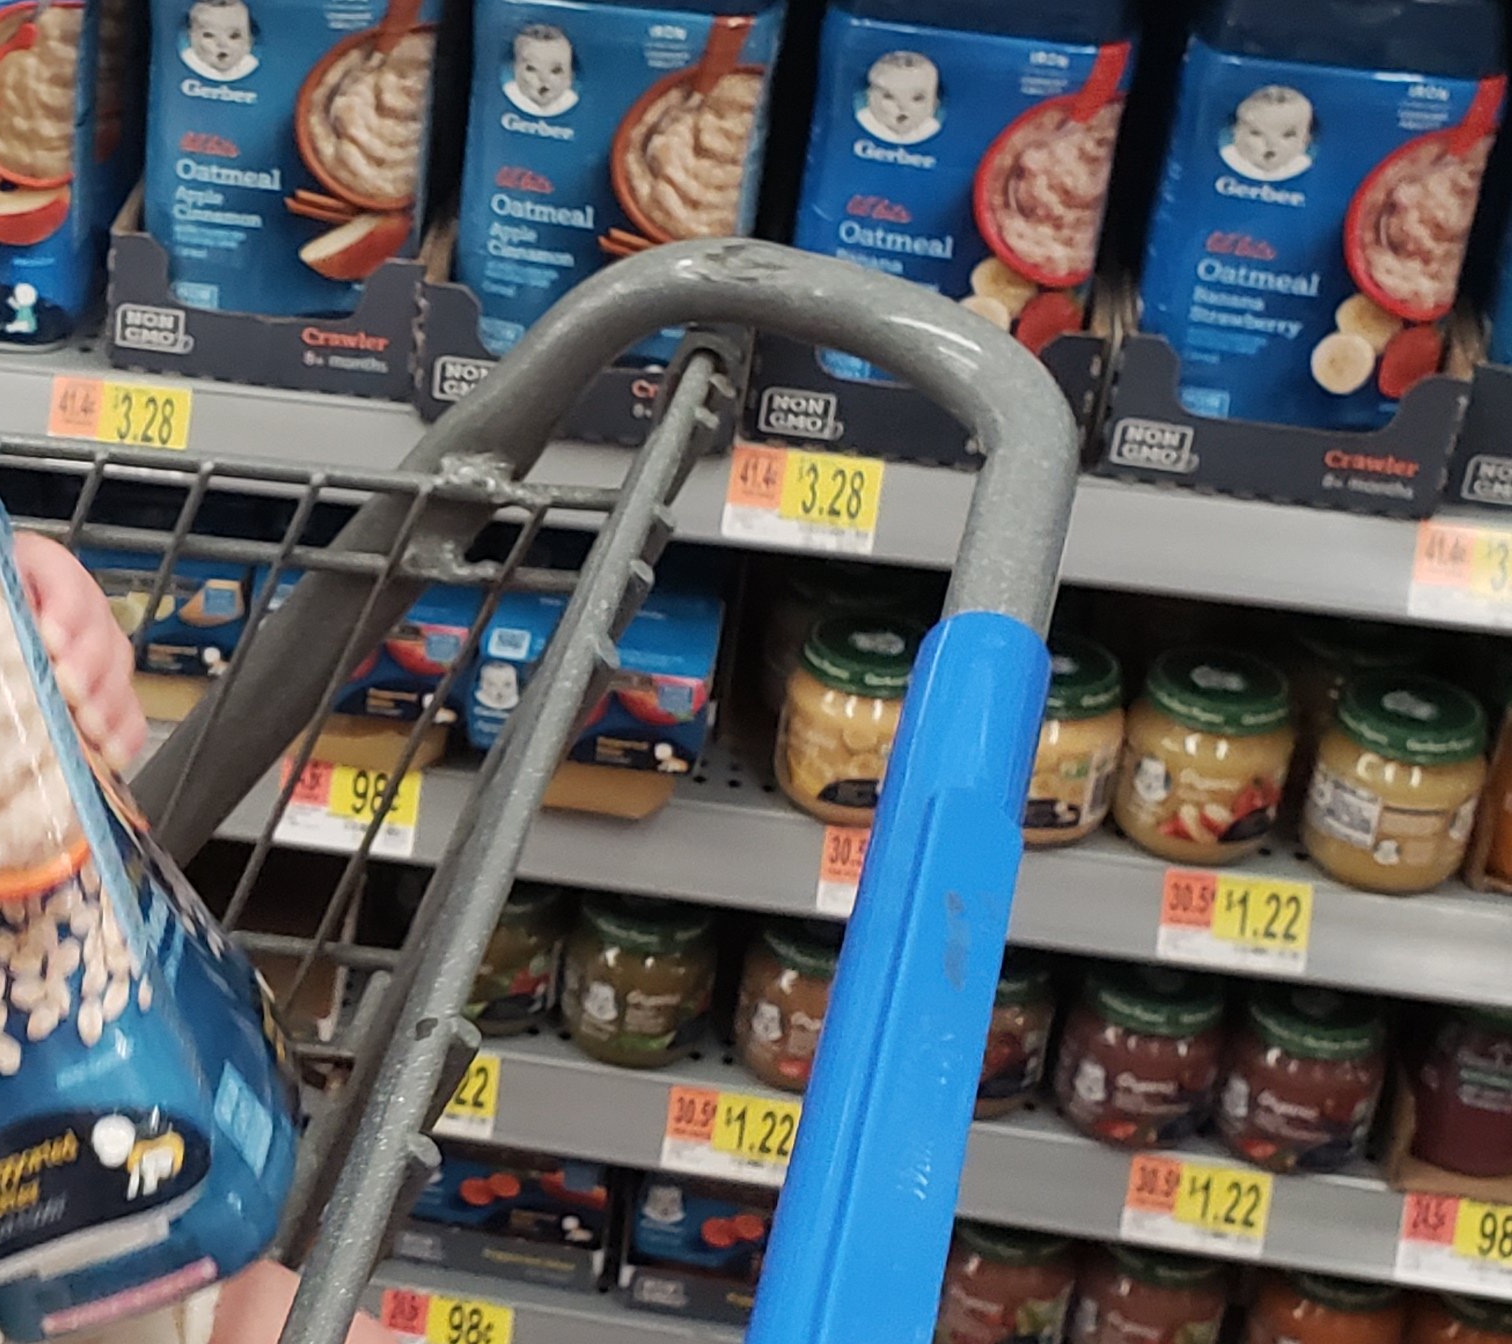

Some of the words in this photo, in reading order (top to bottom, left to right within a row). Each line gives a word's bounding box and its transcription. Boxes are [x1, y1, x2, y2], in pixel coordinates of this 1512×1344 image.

[180, 79, 257, 105] Gerber
[501, 113, 575, 141] Gerber
[853, 138, 937, 170] Gerber
[175, 158, 282, 192] Oatmeal
[1214, 175, 1306, 208] Gerber
[490, 193, 595, 230] Oatmeal
[838, 219, 954, 260] Oatmeal
[1197, 257, 1321, 298] Oatmeal
[125, 310, 175, 331] NON
[123, 327, 177, 348] GMO
[300, 326, 389, 353] Crawler
[774, 394, 826, 415] NON
[768, 410, 824, 433] GMO
[1124, 422, 1182, 448] NON
[1120, 441, 1178, 465] GMO
[1325, 450, 1420, 479] Crawler
